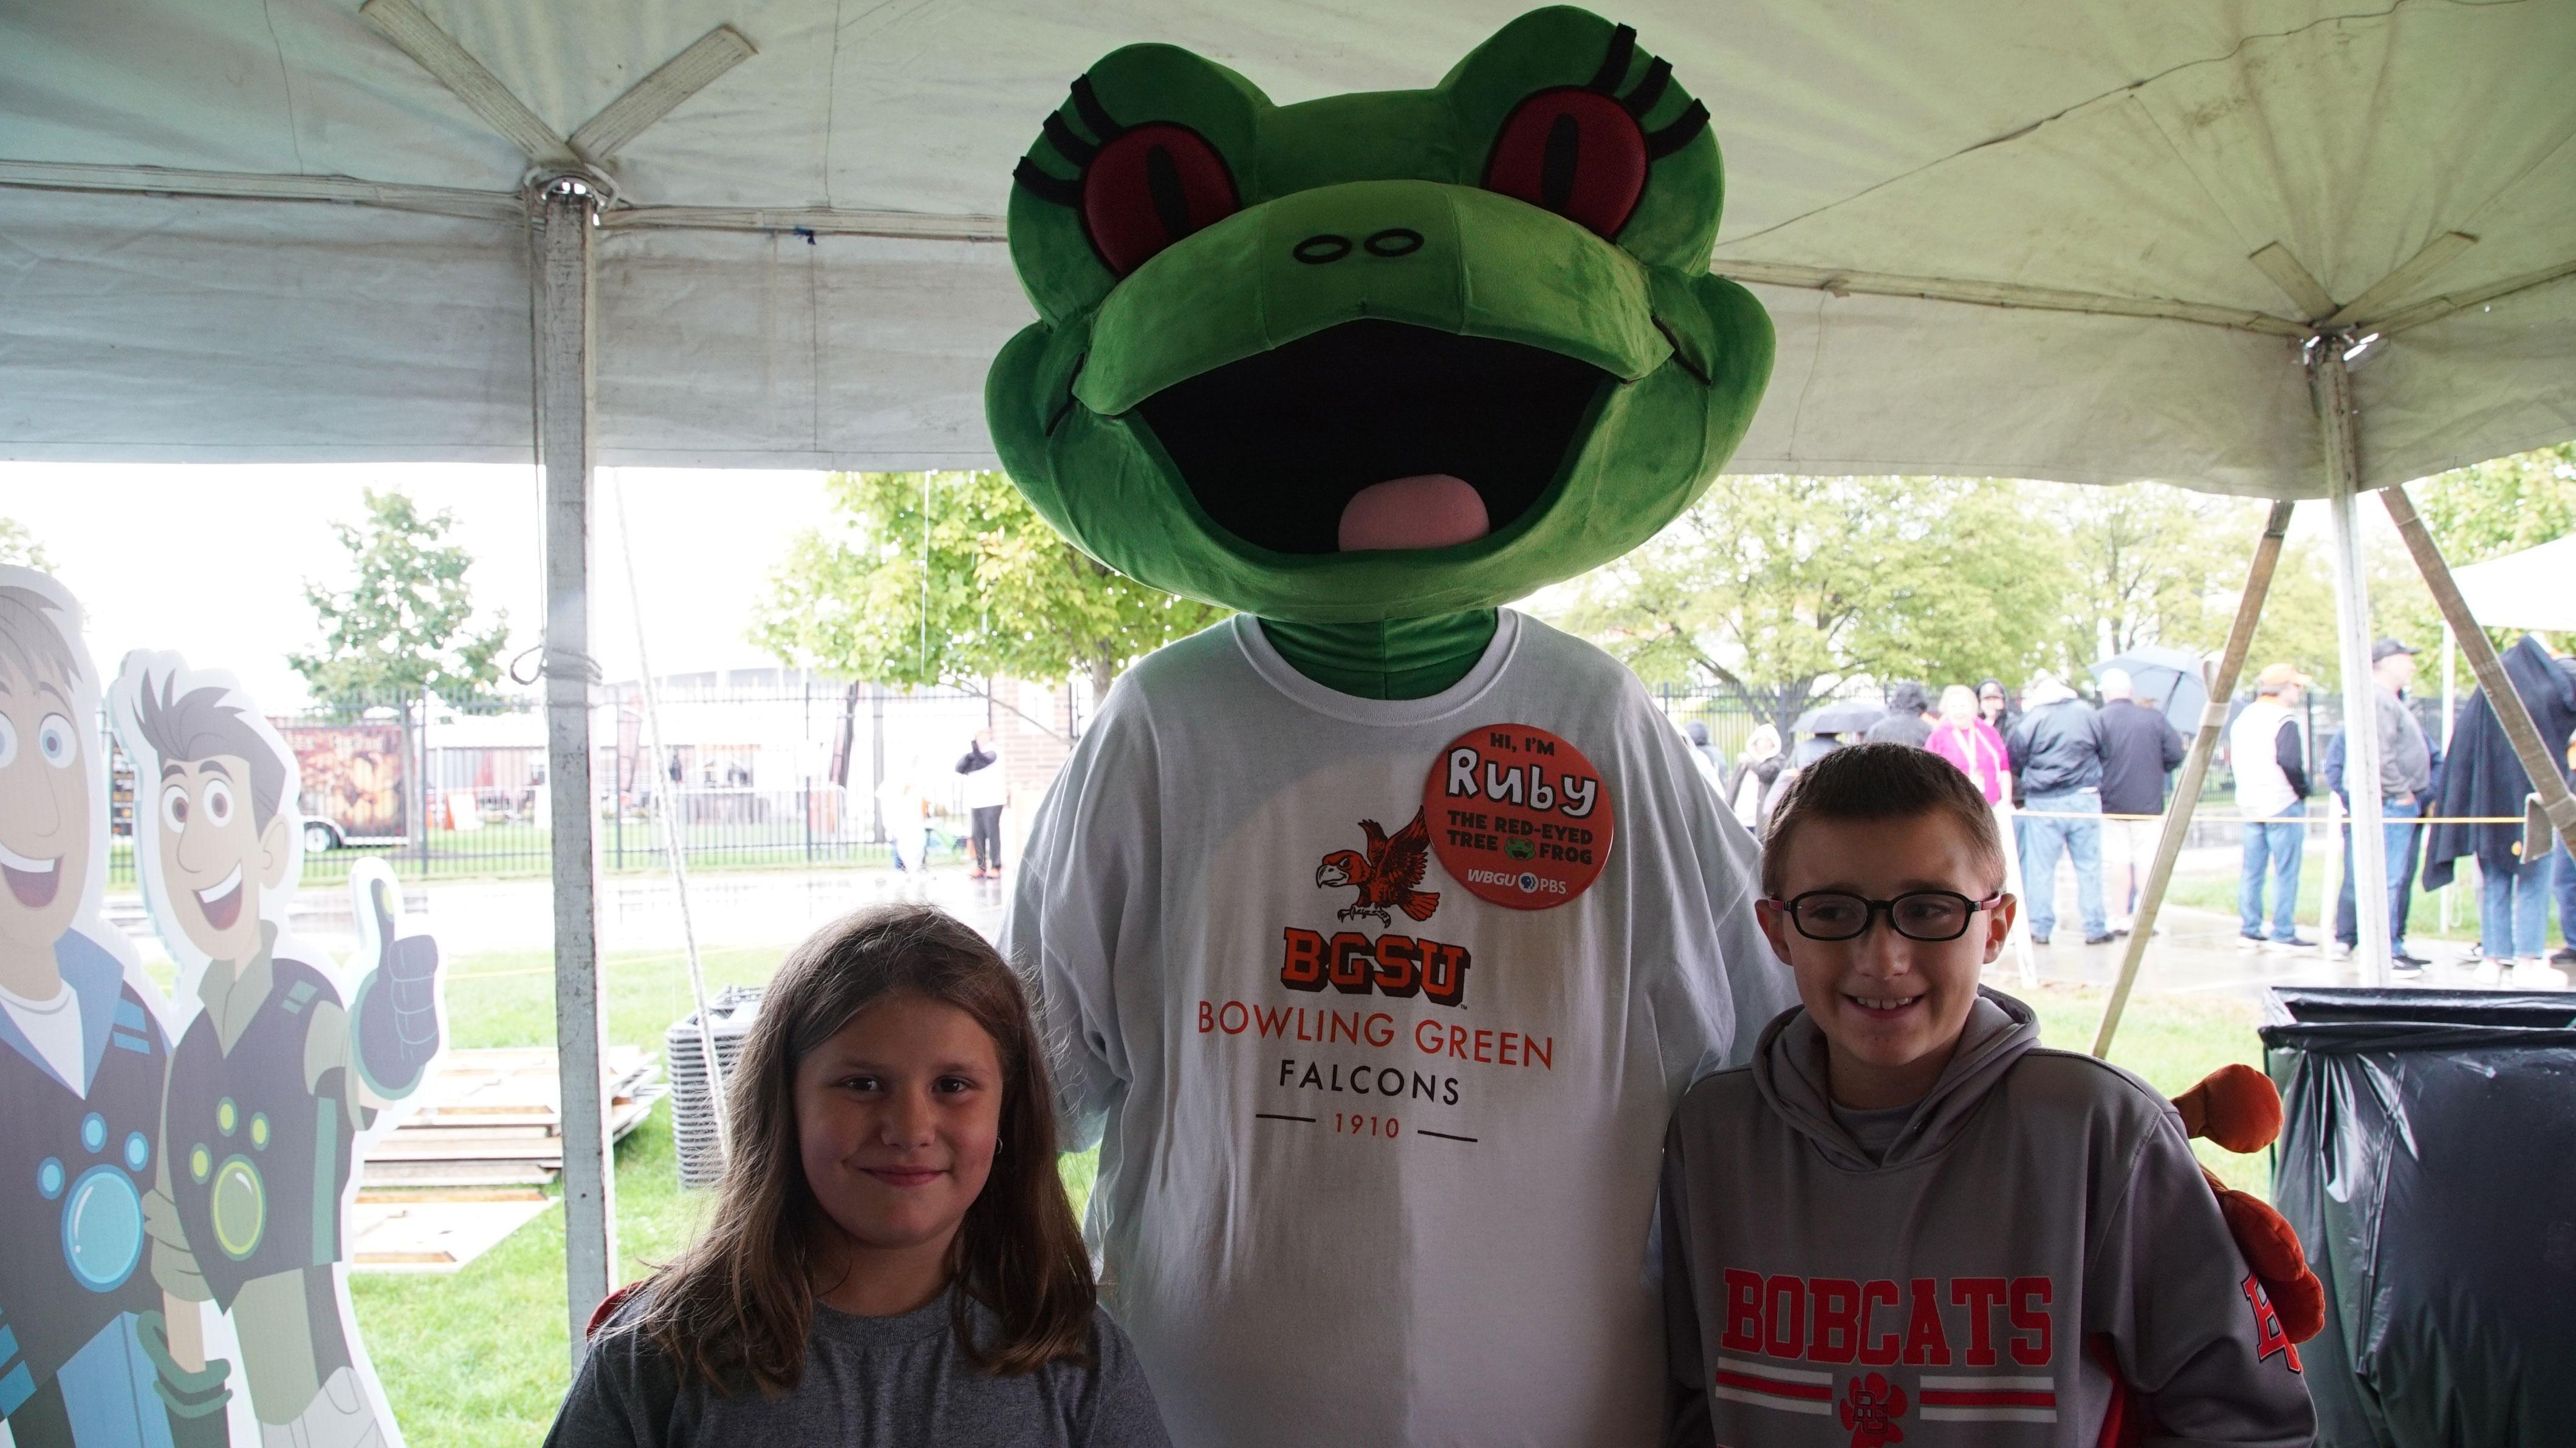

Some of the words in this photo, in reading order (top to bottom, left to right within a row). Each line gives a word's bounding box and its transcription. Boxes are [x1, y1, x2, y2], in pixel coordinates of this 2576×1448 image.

[1490, 733, 1517, 753] HI,
[1526, 737, 1554, 756] I'M
[1446, 745, 1598, 819] Ruby
[1447, 810, 1487, 830] THE
[1495, 816, 1593, 844] RED-EYED
[1447, 830, 1498, 851] TREE
[1540, 843, 1592, 865] FROG
[1468, 869, 1516, 887] WBGU
[1540, 878, 1567, 895] PBS
[1280, 927, 1471, 1007] BGSU
[1198, 1000, 1394, 1047] BOWLING
[1415, 1019, 1553, 1070] GREEN
[1279, 1059, 1459, 1105] FALCONS
[1335, 1113, 1400, 1138] 1910
[1721, 1267, 2053, 1367] BOBCATS
